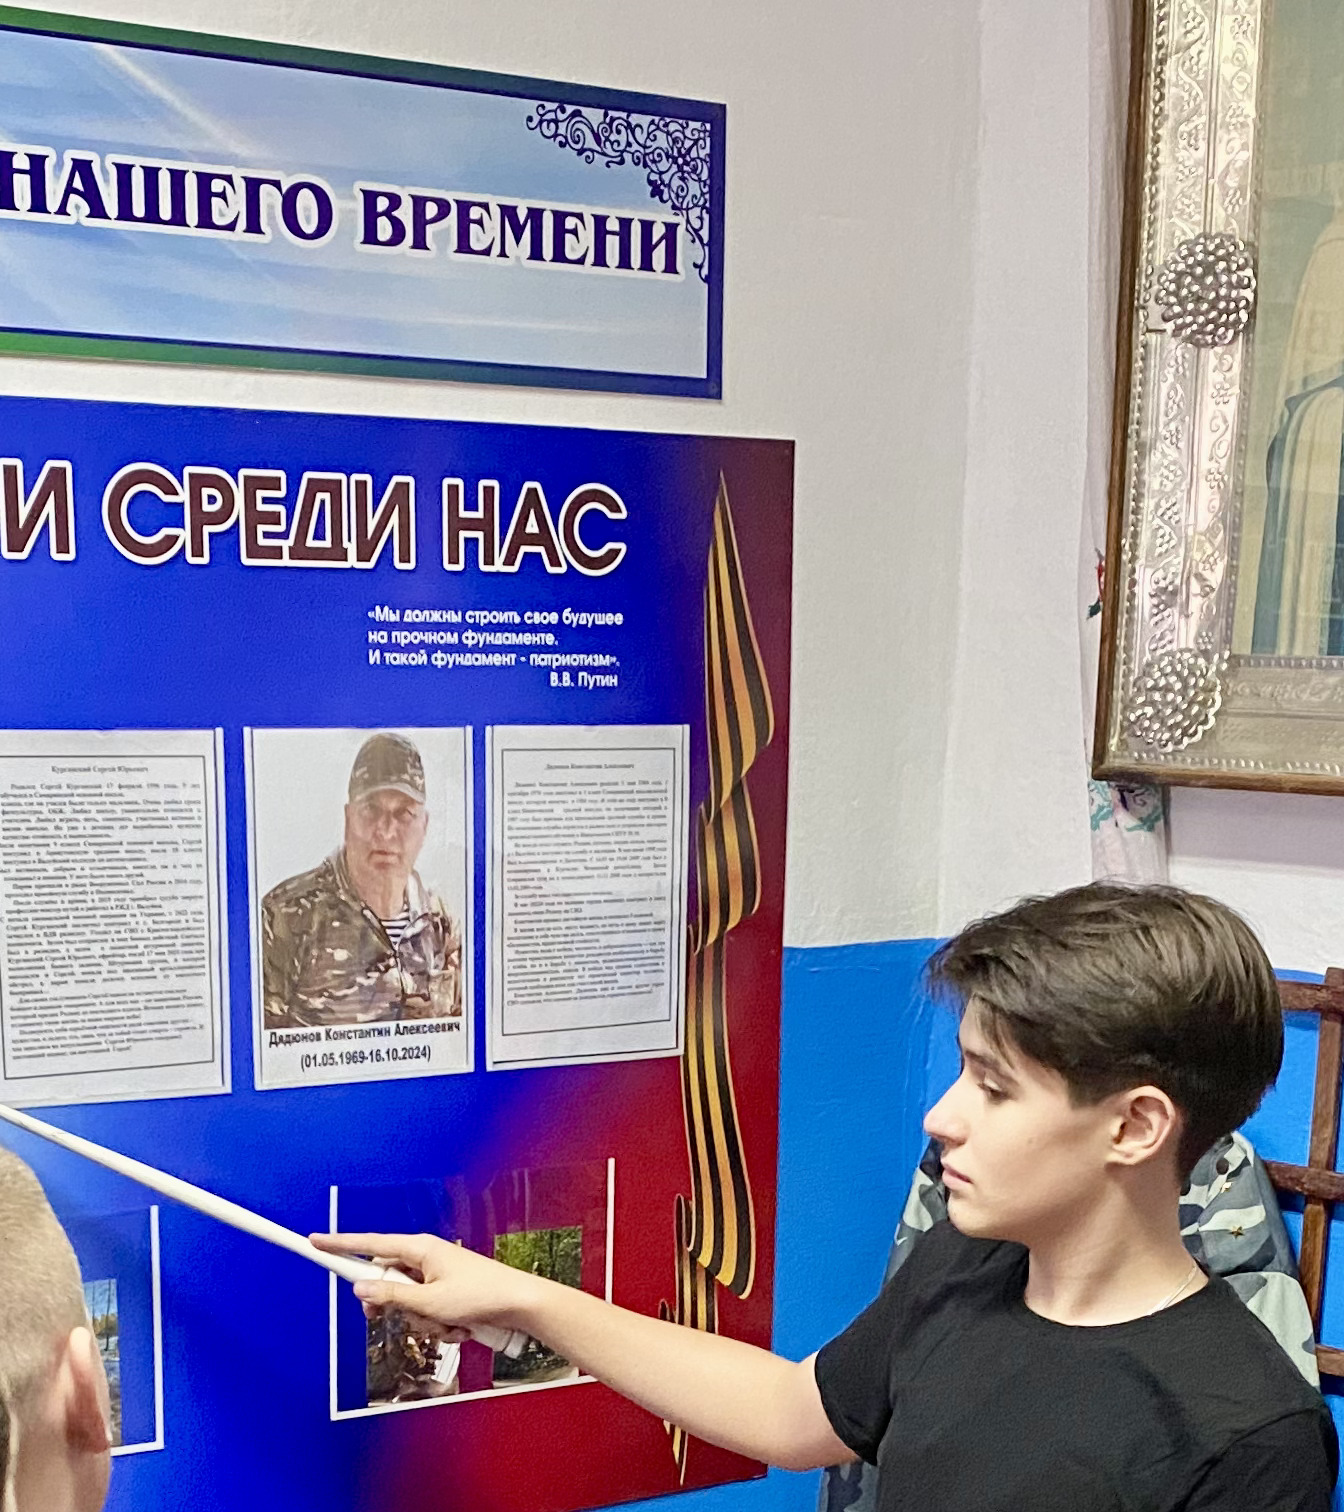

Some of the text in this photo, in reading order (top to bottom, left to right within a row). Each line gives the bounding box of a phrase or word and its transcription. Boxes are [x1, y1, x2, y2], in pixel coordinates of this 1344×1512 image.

[358, 187, 682, 276] ВРЕМЕНИ
[101, 461, 416, 569] СРЕДИ
[443, 475, 629, 577] НАС
[403, 608, 462, 624] должны
[465, 610, 521, 626] строить
[524, 610, 559, 624] свое
[367, 629, 558, 648] на прочном фундаменте.
[368, 649, 381, 665] И
[384, 649, 427, 665] такой
[431, 650, 516, 667] фундамент
[550, 671, 618, 689] В.В. Путин
[324, 1026, 391, 1042] Константин
[394, 1021, 461, 1037] Алексеевич
